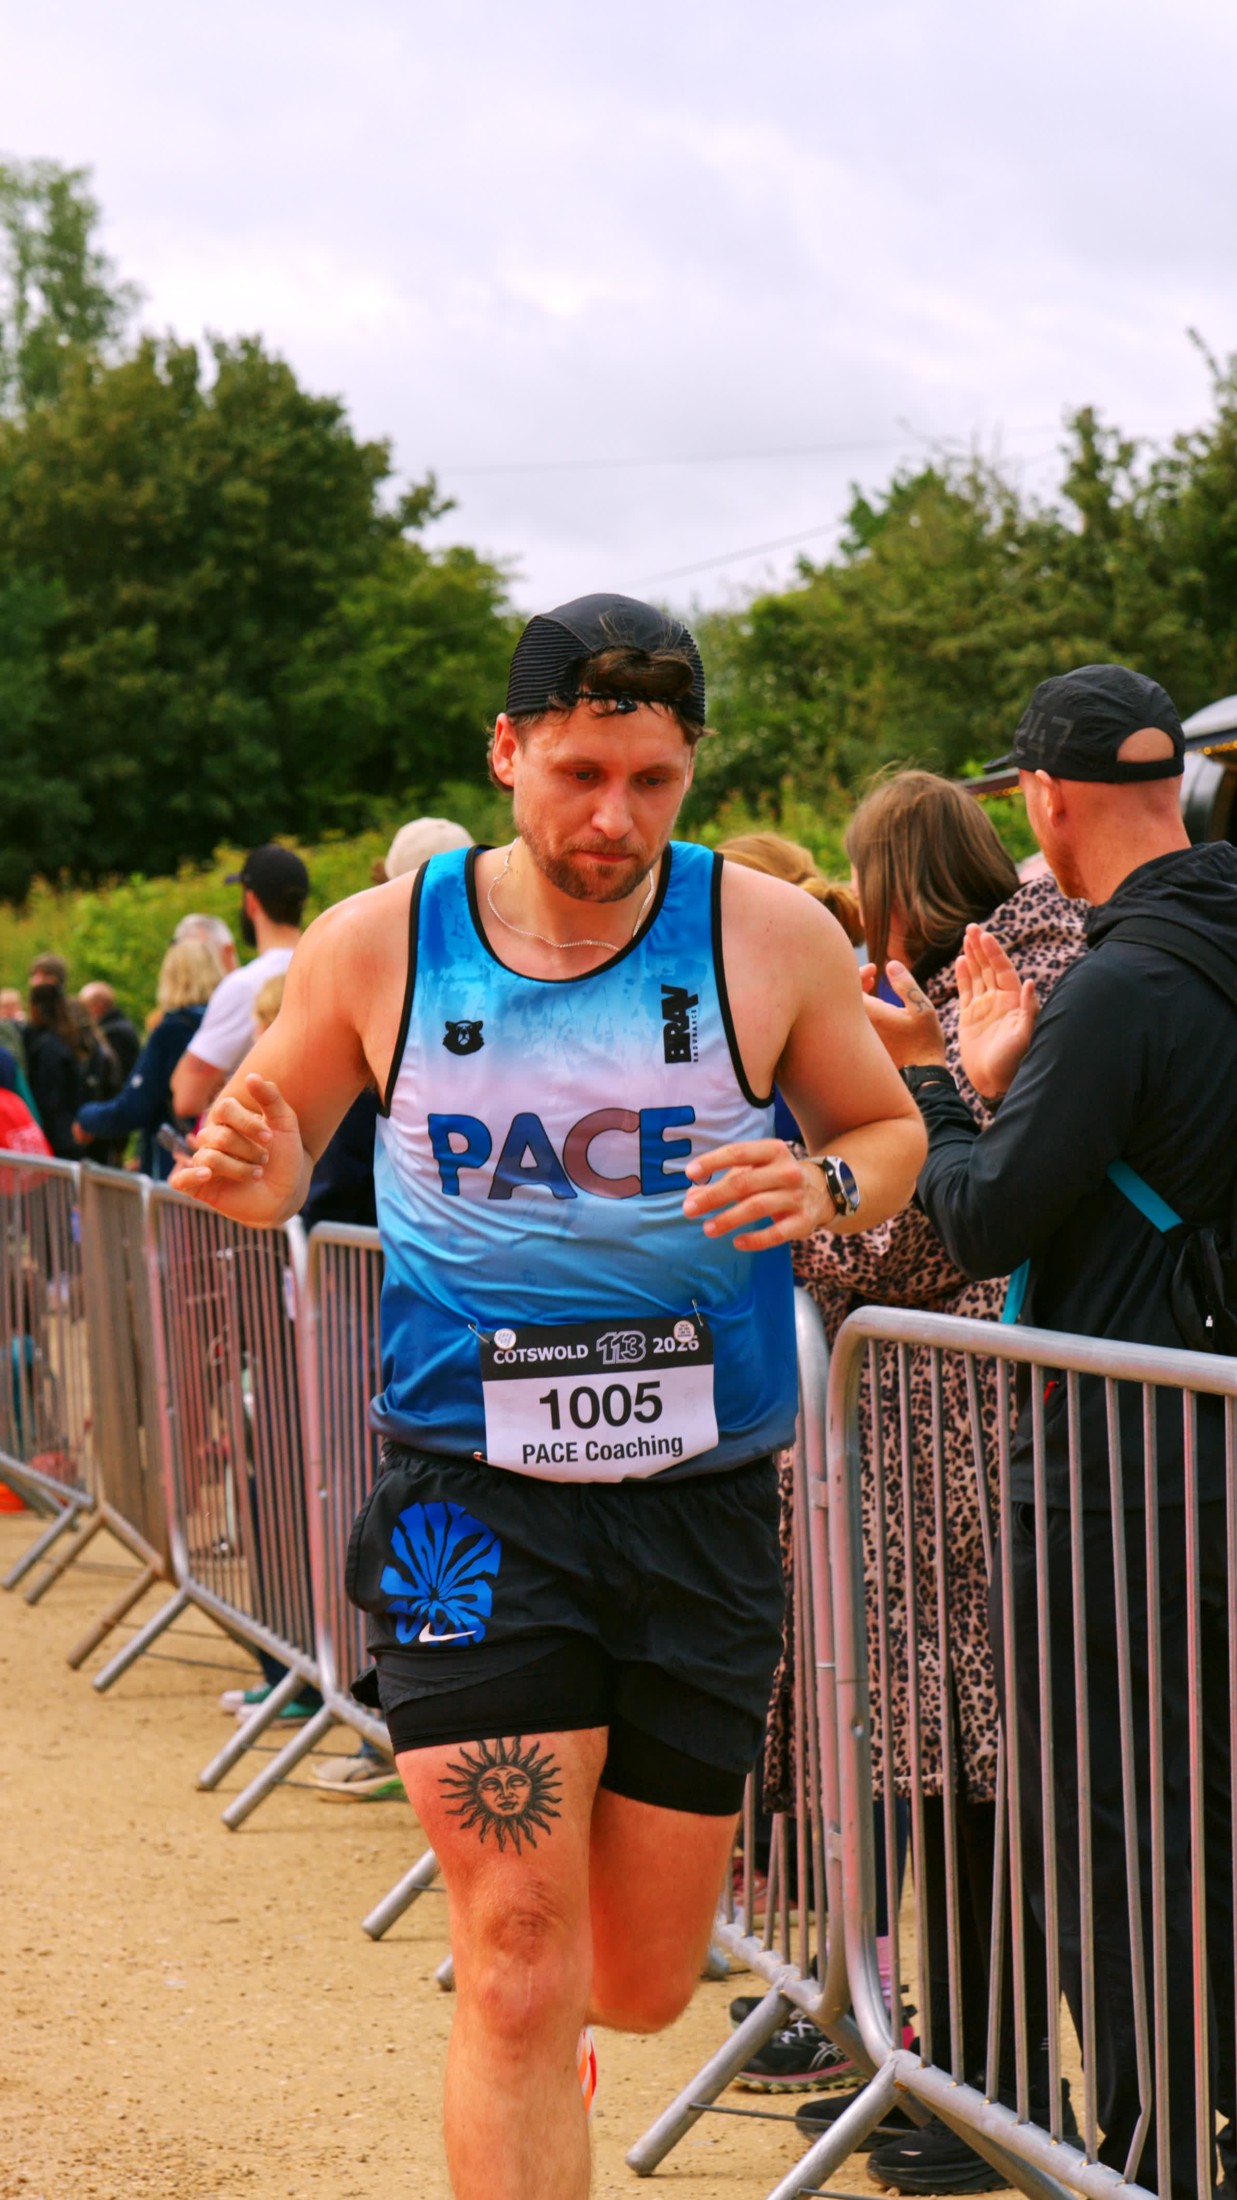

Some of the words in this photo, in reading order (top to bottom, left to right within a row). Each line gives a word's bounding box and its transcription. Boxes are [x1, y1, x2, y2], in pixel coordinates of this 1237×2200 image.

[427, 1105, 696, 1199] PACE
[493, 1344, 589, 1364] COTSWOLD
[596, 1330, 647, 1365] 113
[539, 1380, 663, 1431] 1005
[522, 1441, 579, 1465] PACE
[585, 1435, 684, 1462] Coaching
